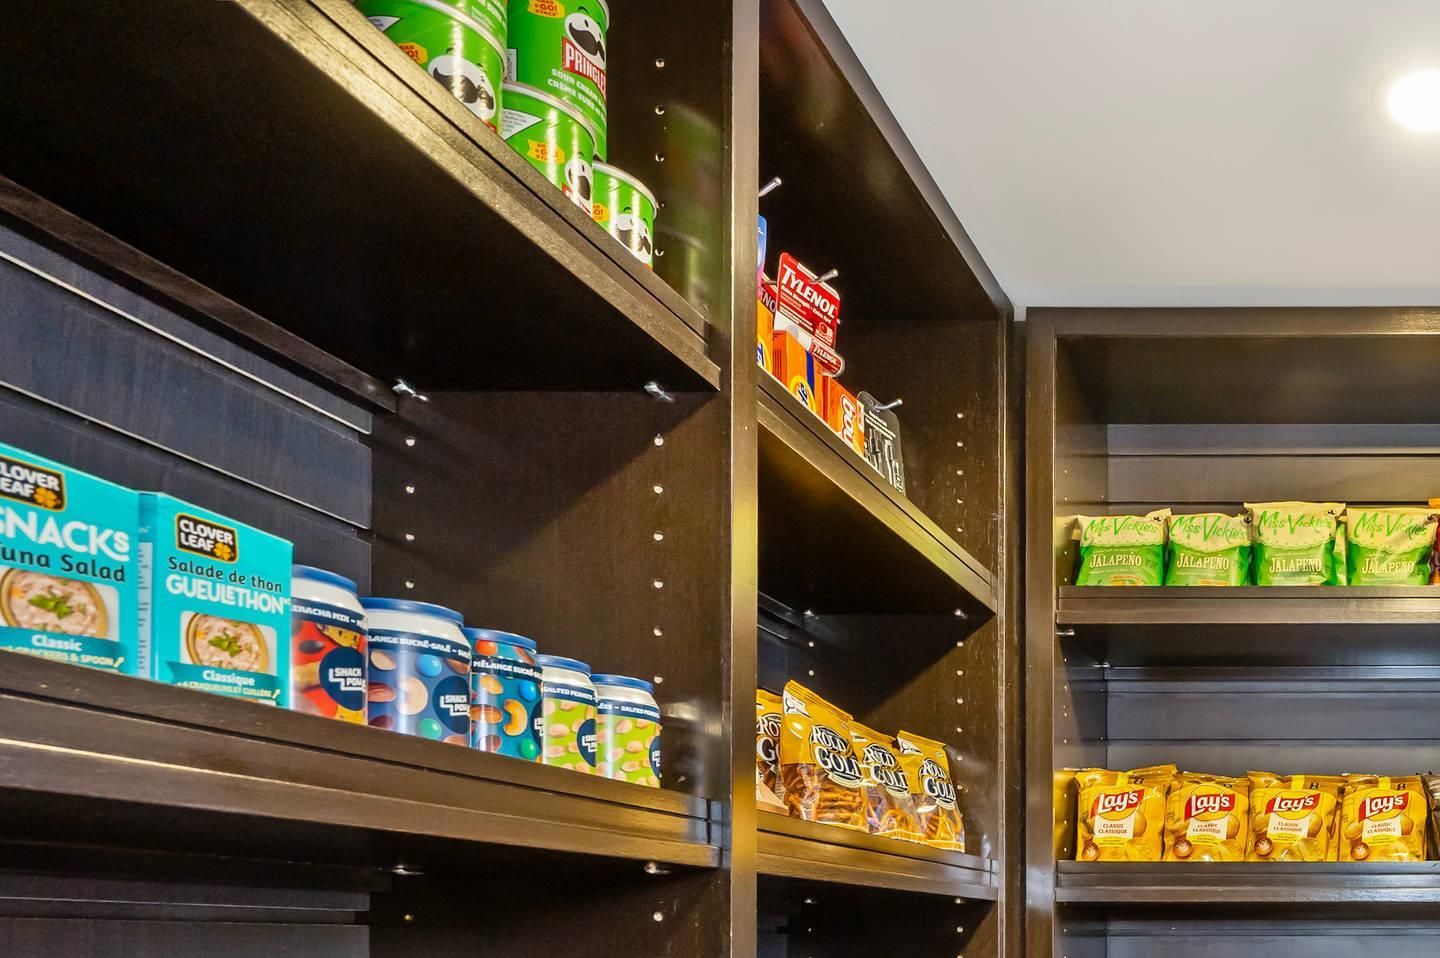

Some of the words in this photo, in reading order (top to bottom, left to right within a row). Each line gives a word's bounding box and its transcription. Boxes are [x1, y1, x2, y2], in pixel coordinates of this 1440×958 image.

[564, 42, 607, 96] PRINGLE
[782, 264, 837, 320] TYLENOL
[812, 342, 839, 366] TYLENOL
[0, 462, 59, 492] LOVER
[0, 479, 35, 498] EAF
[179, 519, 233, 545] CLOVER
[179, 534, 215, 552] LEAF
[0, 544, 51, 569] una
[61, 553, 126, 583] Salad
[1089, 552, 1142, 568] JALAPEÑO
[1177, 553, 1230, 570] JALAPEÑO
[1269, 555, 1322, 574] JALAPEÑO
[1362, 557, 1415, 574] JALAPEÑO
[168, 556, 224, 580] Salade
[228, 565, 247, 585] de
[251, 575, 282, 593] thon
[31, 634, 83, 652] Classic
[335, 668, 362, 678] SNACK
[473, 657, 512, 672] MÉLANGE
[202, 669, 255, 692] Classique
[811, 726, 847, 752] ROLD
[864, 745, 896, 768] ROLD
[1098, 791, 1139, 815] Lay's
[1192, 793, 1230, 816] Lay's
[1273, 796, 1314, 812] Lay's
[1365, 795, 1404, 817] Lay's
